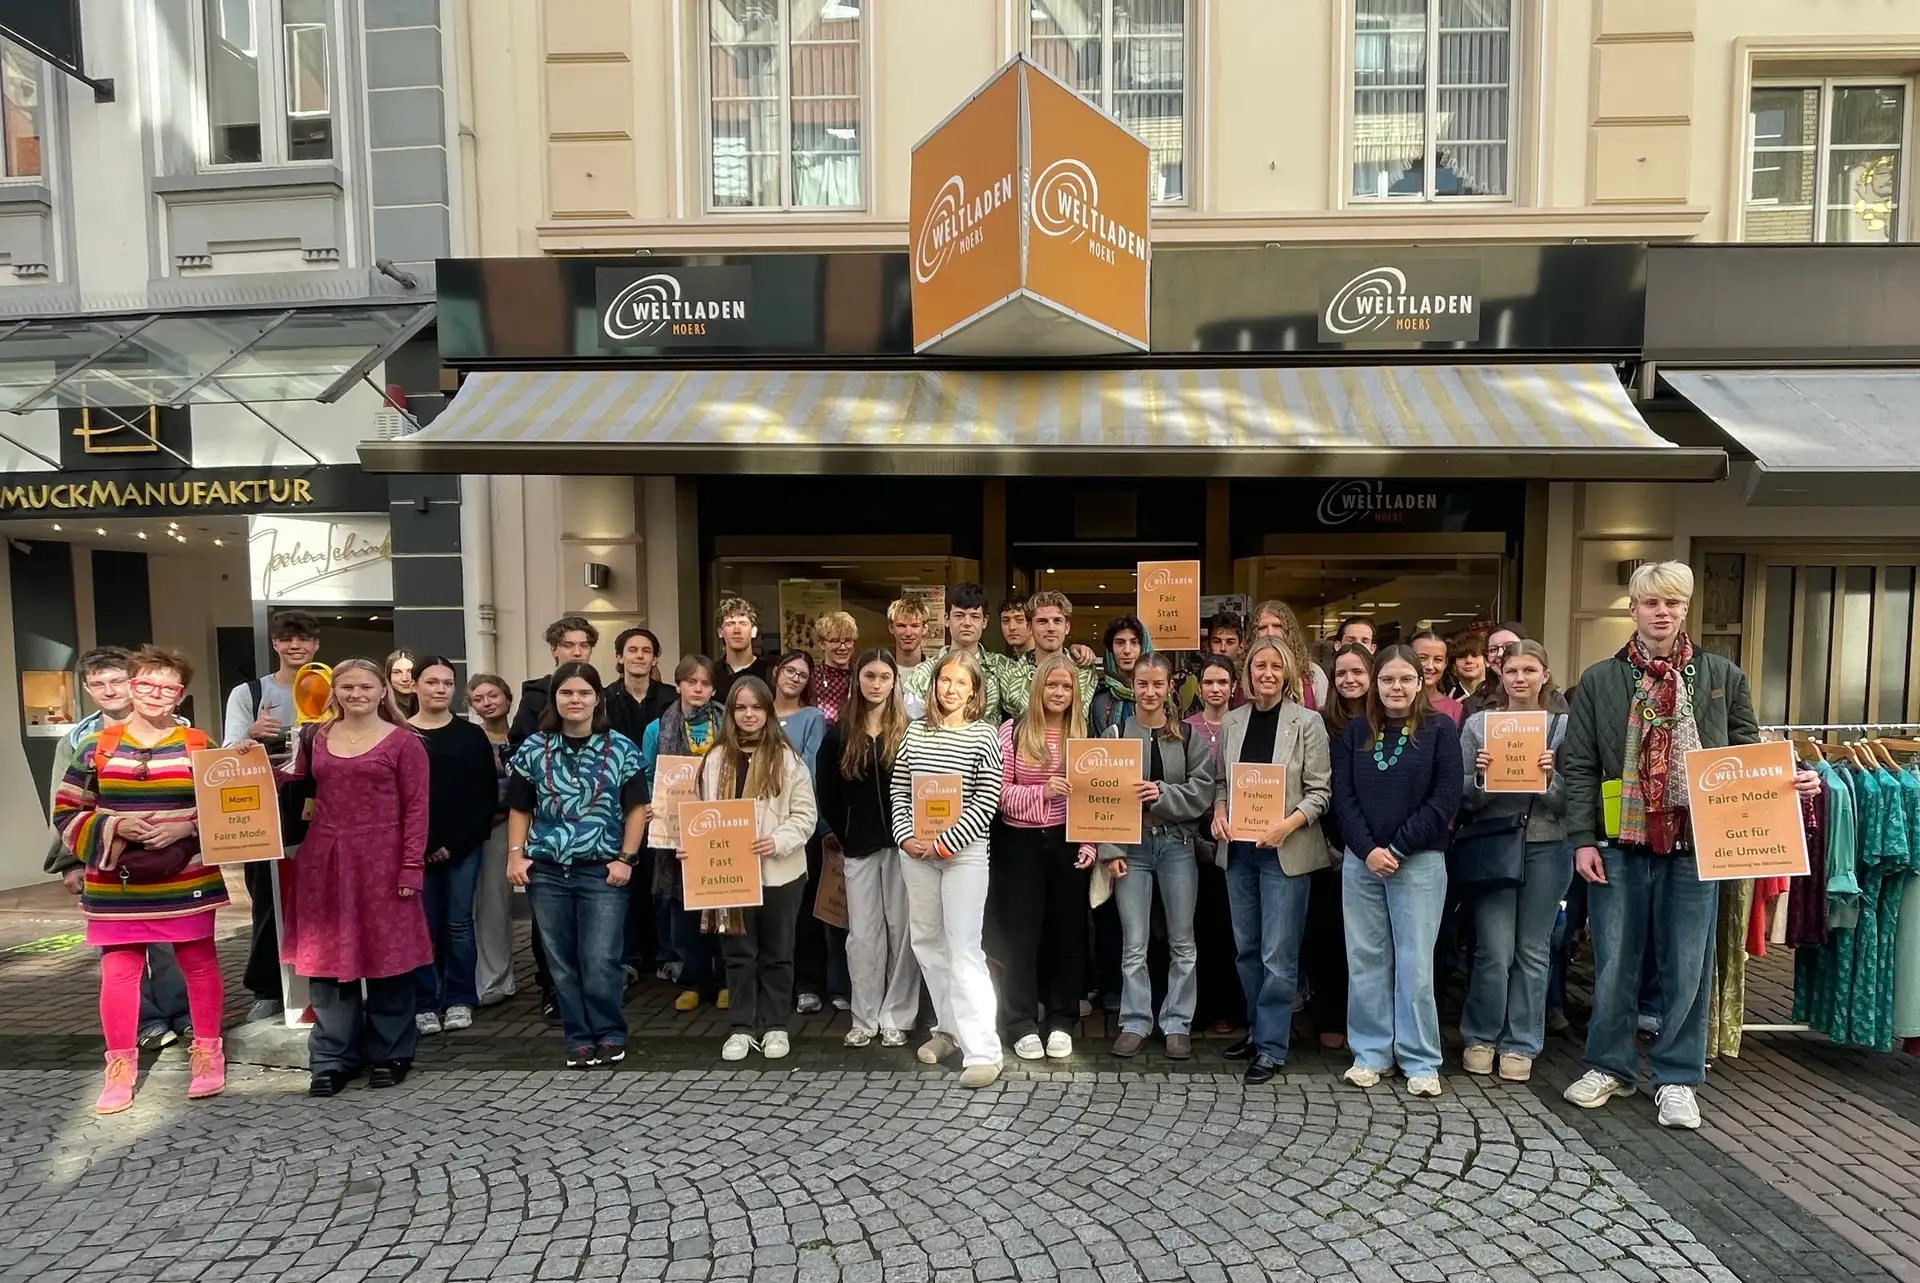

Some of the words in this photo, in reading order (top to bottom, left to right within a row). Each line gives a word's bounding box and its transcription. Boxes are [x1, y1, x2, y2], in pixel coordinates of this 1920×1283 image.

[932, 173, 1012, 250] WELTLADEN
[1057, 188, 1145, 261] WELTLADEN
[959, 226, 984, 256] MOERS
[1088, 239, 1115, 265] MOERS
[632, 300, 745, 320] WELTLADEN
[1356, 295, 1473, 315] WELTLADEN
[672, 323, 706, 335] MOERS
[1396, 318, 1430, 330] MOERS
[0, 478, 314, 510] MUCKMANUFAKTUR
[1342, 494, 1437, 509] WELTLADEN
[1159, 594, 1176, 602] Fair
[1157, 609, 1179, 617] Statt
[1159, 624, 1177, 632] Fast
[1087, 758, 1135, 767] WELTLADEN
[1505, 754, 1526, 762] Statt
[1507, 767, 1525, 775] Fast
[1714, 766, 1783, 781] WELTLADEN
[1090, 778, 1119, 788] Good
[228, 796, 253, 804] Moers
[1088, 794, 1121, 804] Better
[1243, 791, 1273, 799] Fashion
[1708, 794, 1739, 805] Faire
[1741, 790, 1778, 802] Mode
[1251, 804, 1263, 812] for
[228, 815, 251, 825] trägt
[1094, 811, 1115, 821] Fair
[1244, 817, 1269, 825] Future
[700, 818, 749, 829] WELTLADEN
[214, 832, 237, 841] Faire
[239, 829, 267, 839] Mode
[1725, 829, 1748, 839] Gut
[1751, 827, 1770, 837] für
[709, 839, 730, 849] Exit
[1714, 848, 1733, 858] die
[1736, 844, 1787, 856] Umwelt
[709, 857, 733, 868] Fast
[701, 873, 744, 886] Fashion
